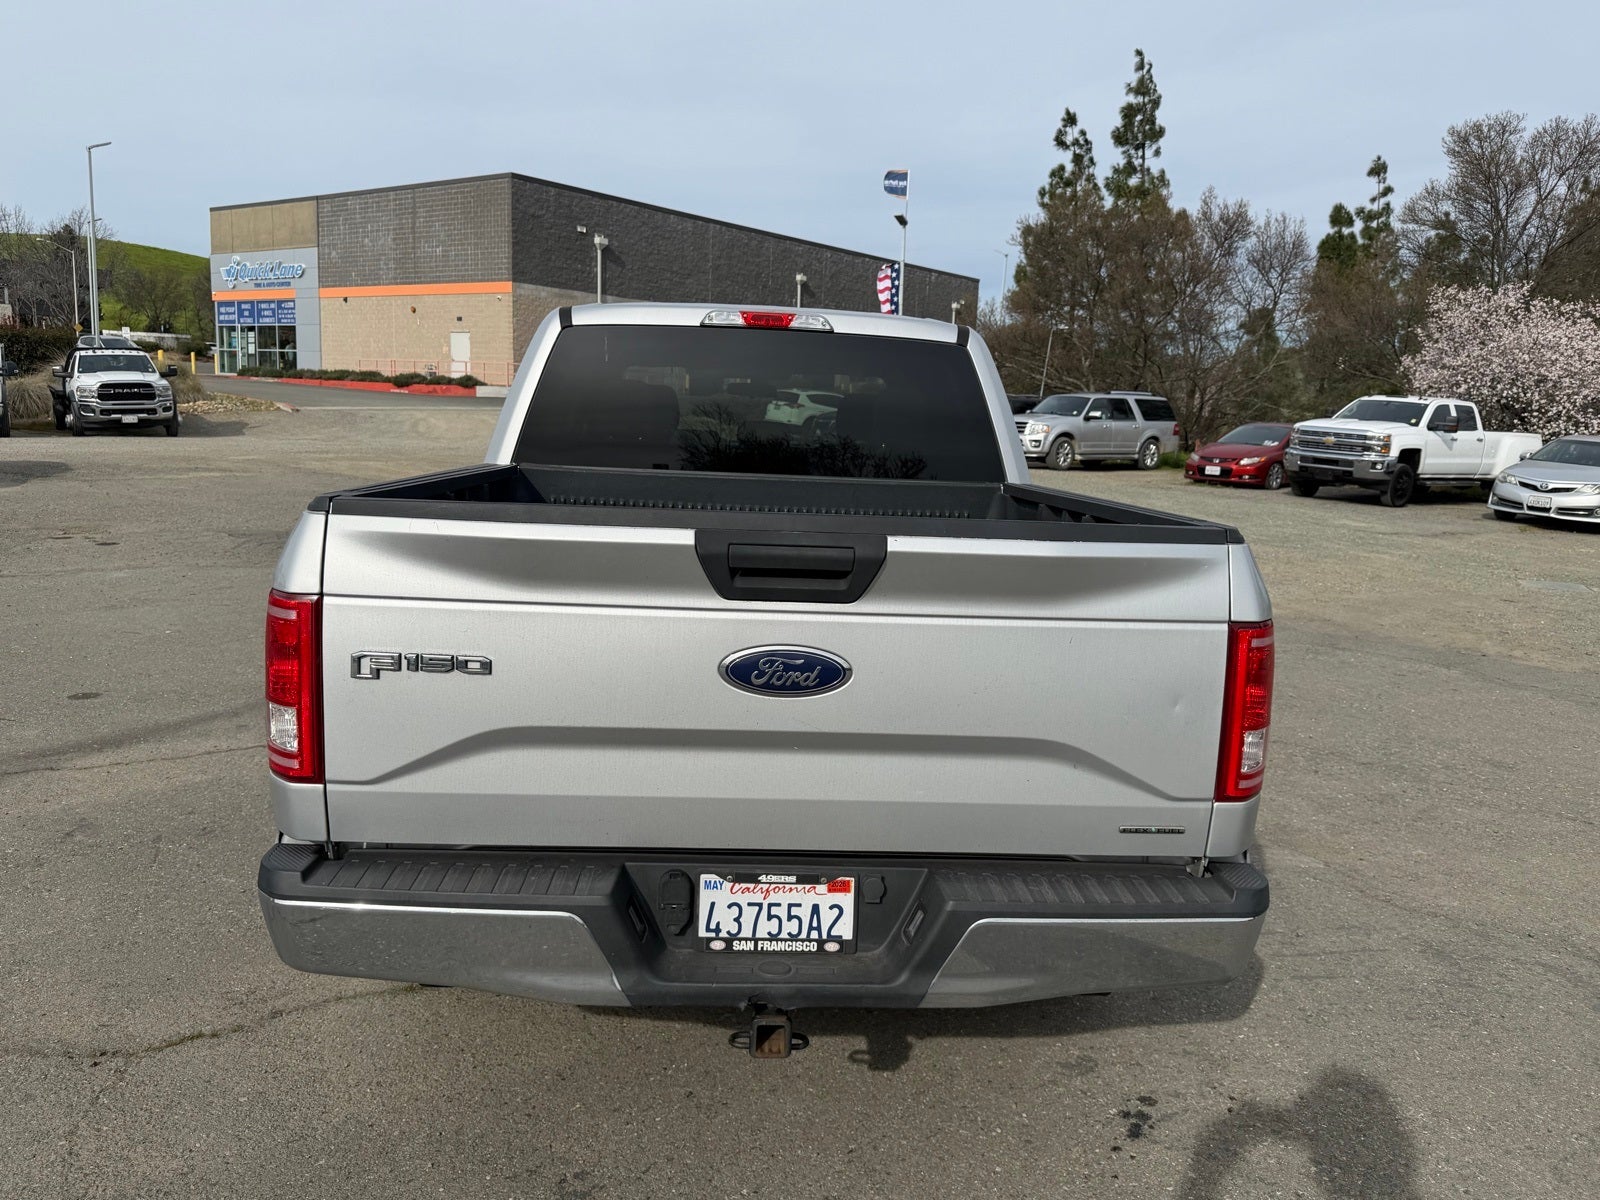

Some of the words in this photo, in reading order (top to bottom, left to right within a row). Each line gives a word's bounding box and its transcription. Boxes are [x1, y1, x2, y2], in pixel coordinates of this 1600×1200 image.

[238, 262, 273, 282] Quick
[274, 260, 305, 279] Lane
[751, 656, 821, 686] Ford
[704, 880, 724, 890] MAY
[758, 874, 797, 882] 49ERS
[730, 883, 827, 900] California
[705, 901, 844, 939] 43755A2
[732, 941, 754, 950] SAN
[758, 941, 817, 951] FRANCISCO
